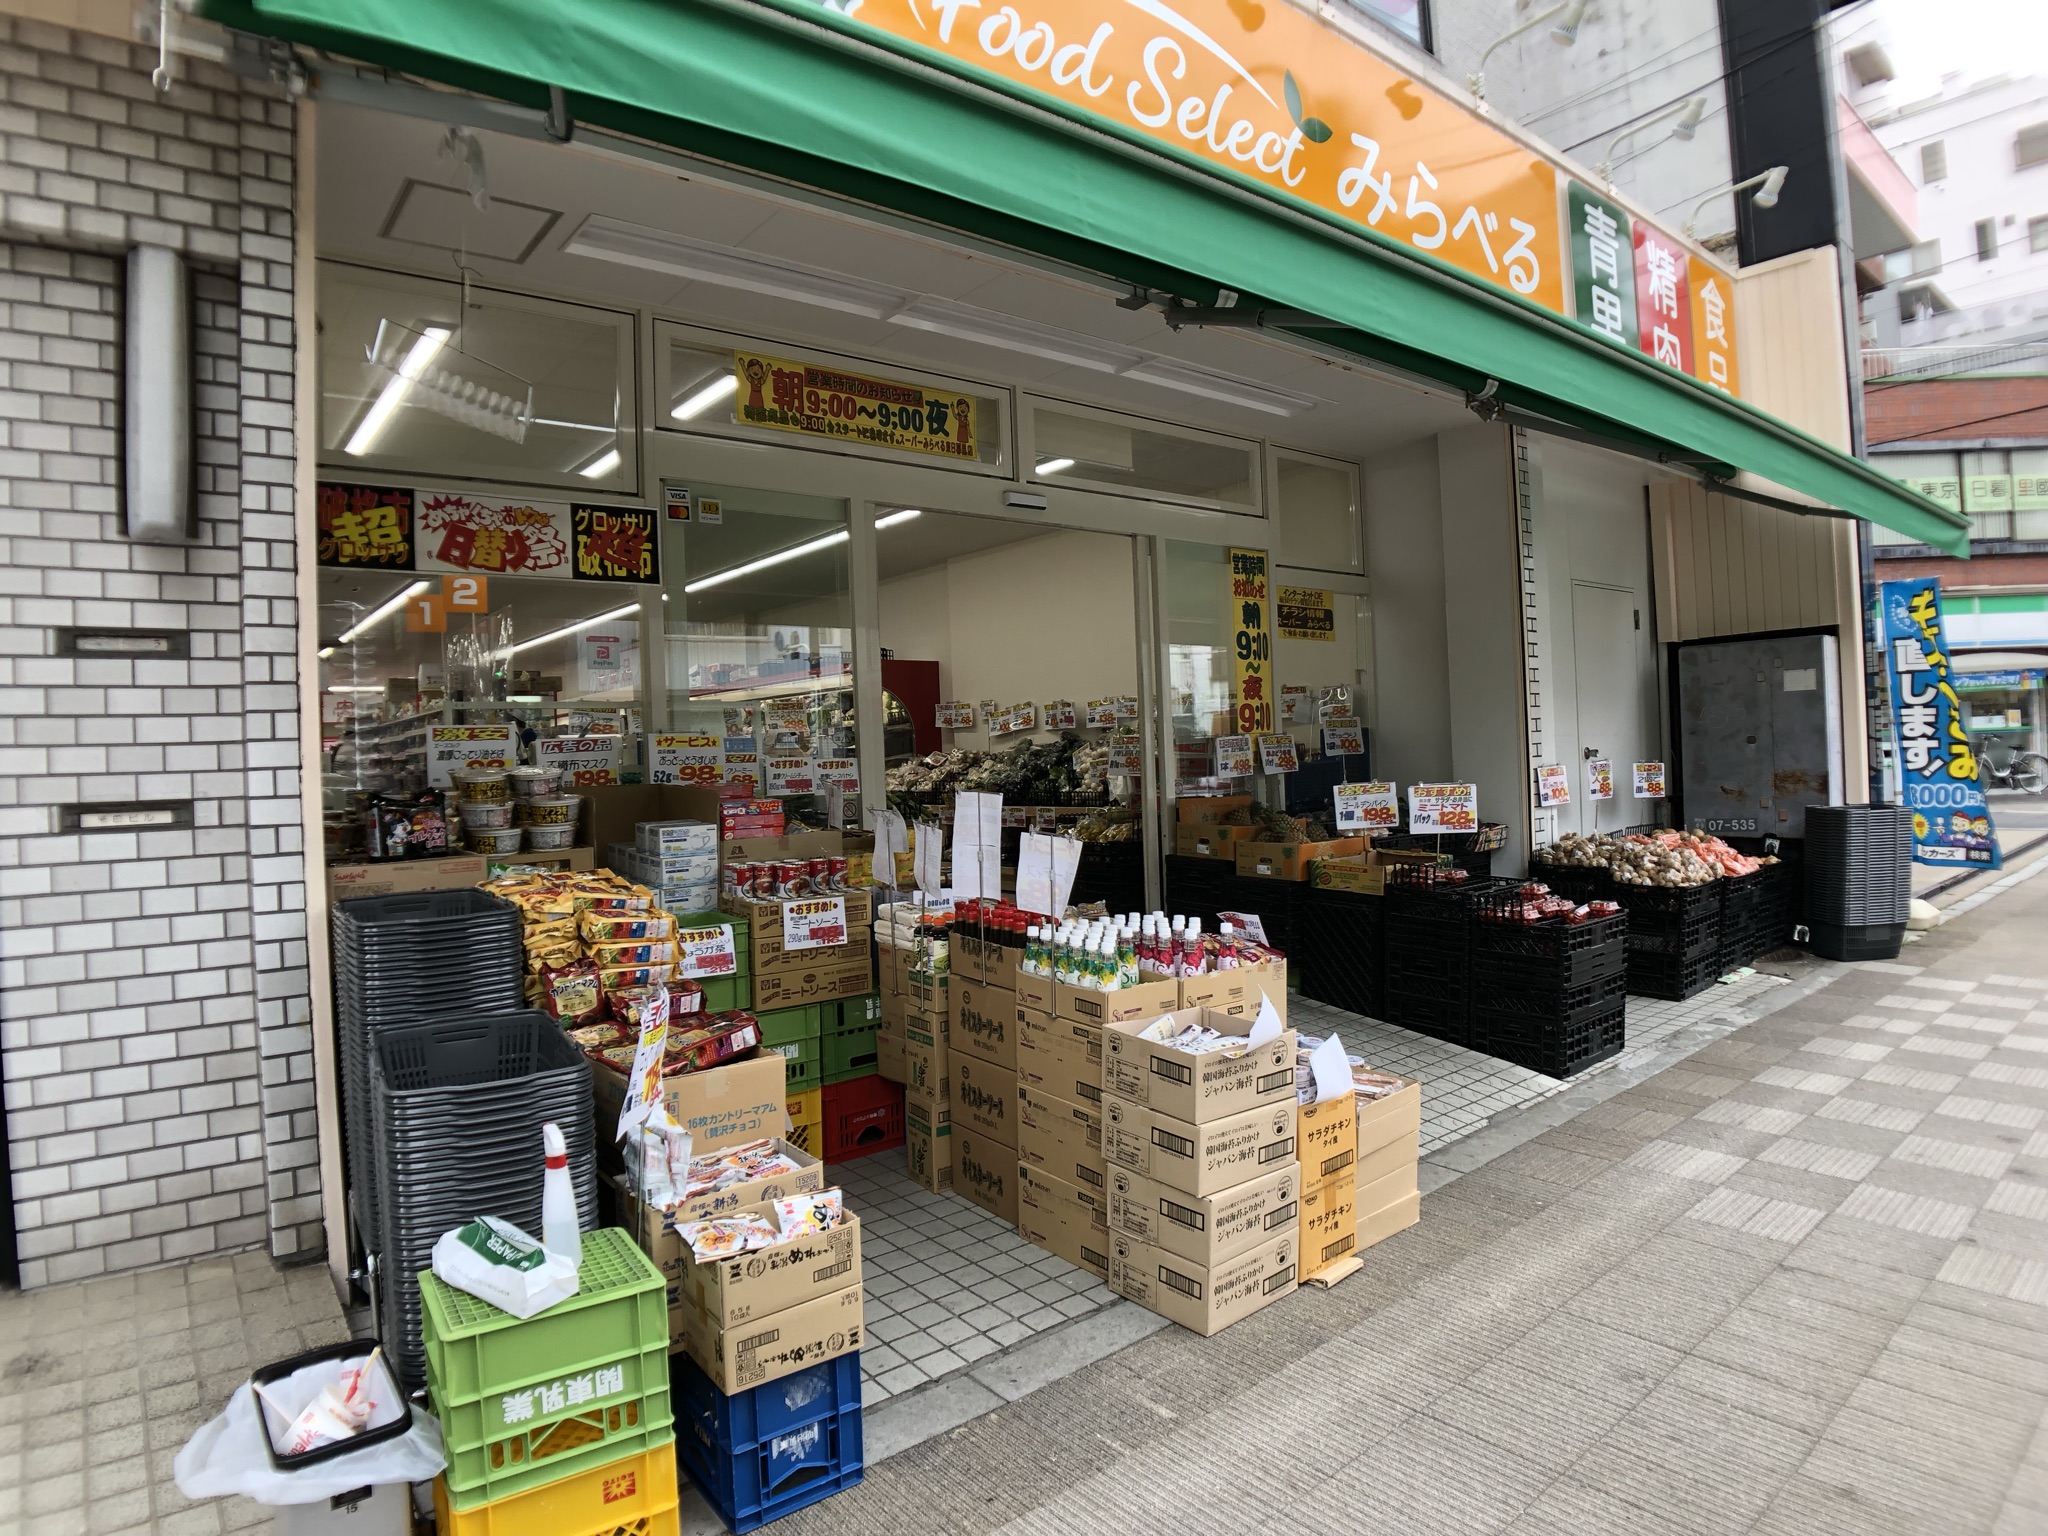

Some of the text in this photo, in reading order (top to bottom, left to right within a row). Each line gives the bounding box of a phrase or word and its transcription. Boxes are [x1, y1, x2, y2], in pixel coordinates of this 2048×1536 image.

[1126, 36, 1307, 188] Select
[1336, 131, 1541, 295] みらべる
[1645, 238, 1684, 373] 精肉
[670, 492, 687, 500] VISA
[574, 507, 652, 537] グロッサリ
[453, 579, 478, 605] 2
[417, 602, 432, 626] 1
[1235, 630, 1269, 662] 9:00
[1238, 702, 1271, 733] 9:00
[541, 738, 613, 754] 広告の品
[663, 736, 712, 748] サービス
[774, 759, 804, 769] おすすめ!
[821, 760, 850, 770] おすすめ!
[652, 770, 673, 783] 52g
[1413, 785, 1472, 797] おすすめ!
[1342, 799, 1390, 810] ゴールデンパイン
[1417, 802, 1469, 812] ミニトマト
[1361, 806, 1397, 822] 198円
[1438, 810, 1476, 826] 128円
[1708, 819, 1756, 831] 07-535
[794, 902, 833, 916] おすすめ!
[791, 916, 839, 930] ミートソース
[678, 929, 720, 944] おすすめ!
[686, 945, 727, 958] ょうが茶
[781, 947, 837, 964] ミートソース
[550, 978, 598, 998] カントリーマアム
[781, 981, 838, 1000] ミートソース
[1202, 1061, 1258, 1084] 韓国海苔ふりかけ
[1205, 1075, 1253, 1098] ジャパン海苔
[687, 1103, 777, 1130] 16枚カントリーマアム
[1308, 1118, 1351, 1143] サラダチキン
[1205, 1131, 1260, 1157] 韓国海苔ふりかけ
[1323, 1136, 1338, 1148] タイ産
[1207, 1146, 1255, 1170] ジャパン海苔
[798, 1173, 818, 1187] 15209
[1215, 1199, 1266, 1229] 韓国海苔ふりかけ
[1308, 1203, 1352, 1230] サラダチキン
[1217, 1214, 1261, 1242] ジャパン海苔
[1323, 1222, 1339, 1235] タイ産
[828, 1230, 851, 1244] 25216
[1213, 1265, 1265, 1297] 韓国海苔ふりかけ
[1216, 1280, 1260, 1309] ジャパン海苔
[738, 1368, 764, 1384] 25216
[502, 1363, 624, 1425] 関東乳業
[344, 1503, 358, 1515] 15
